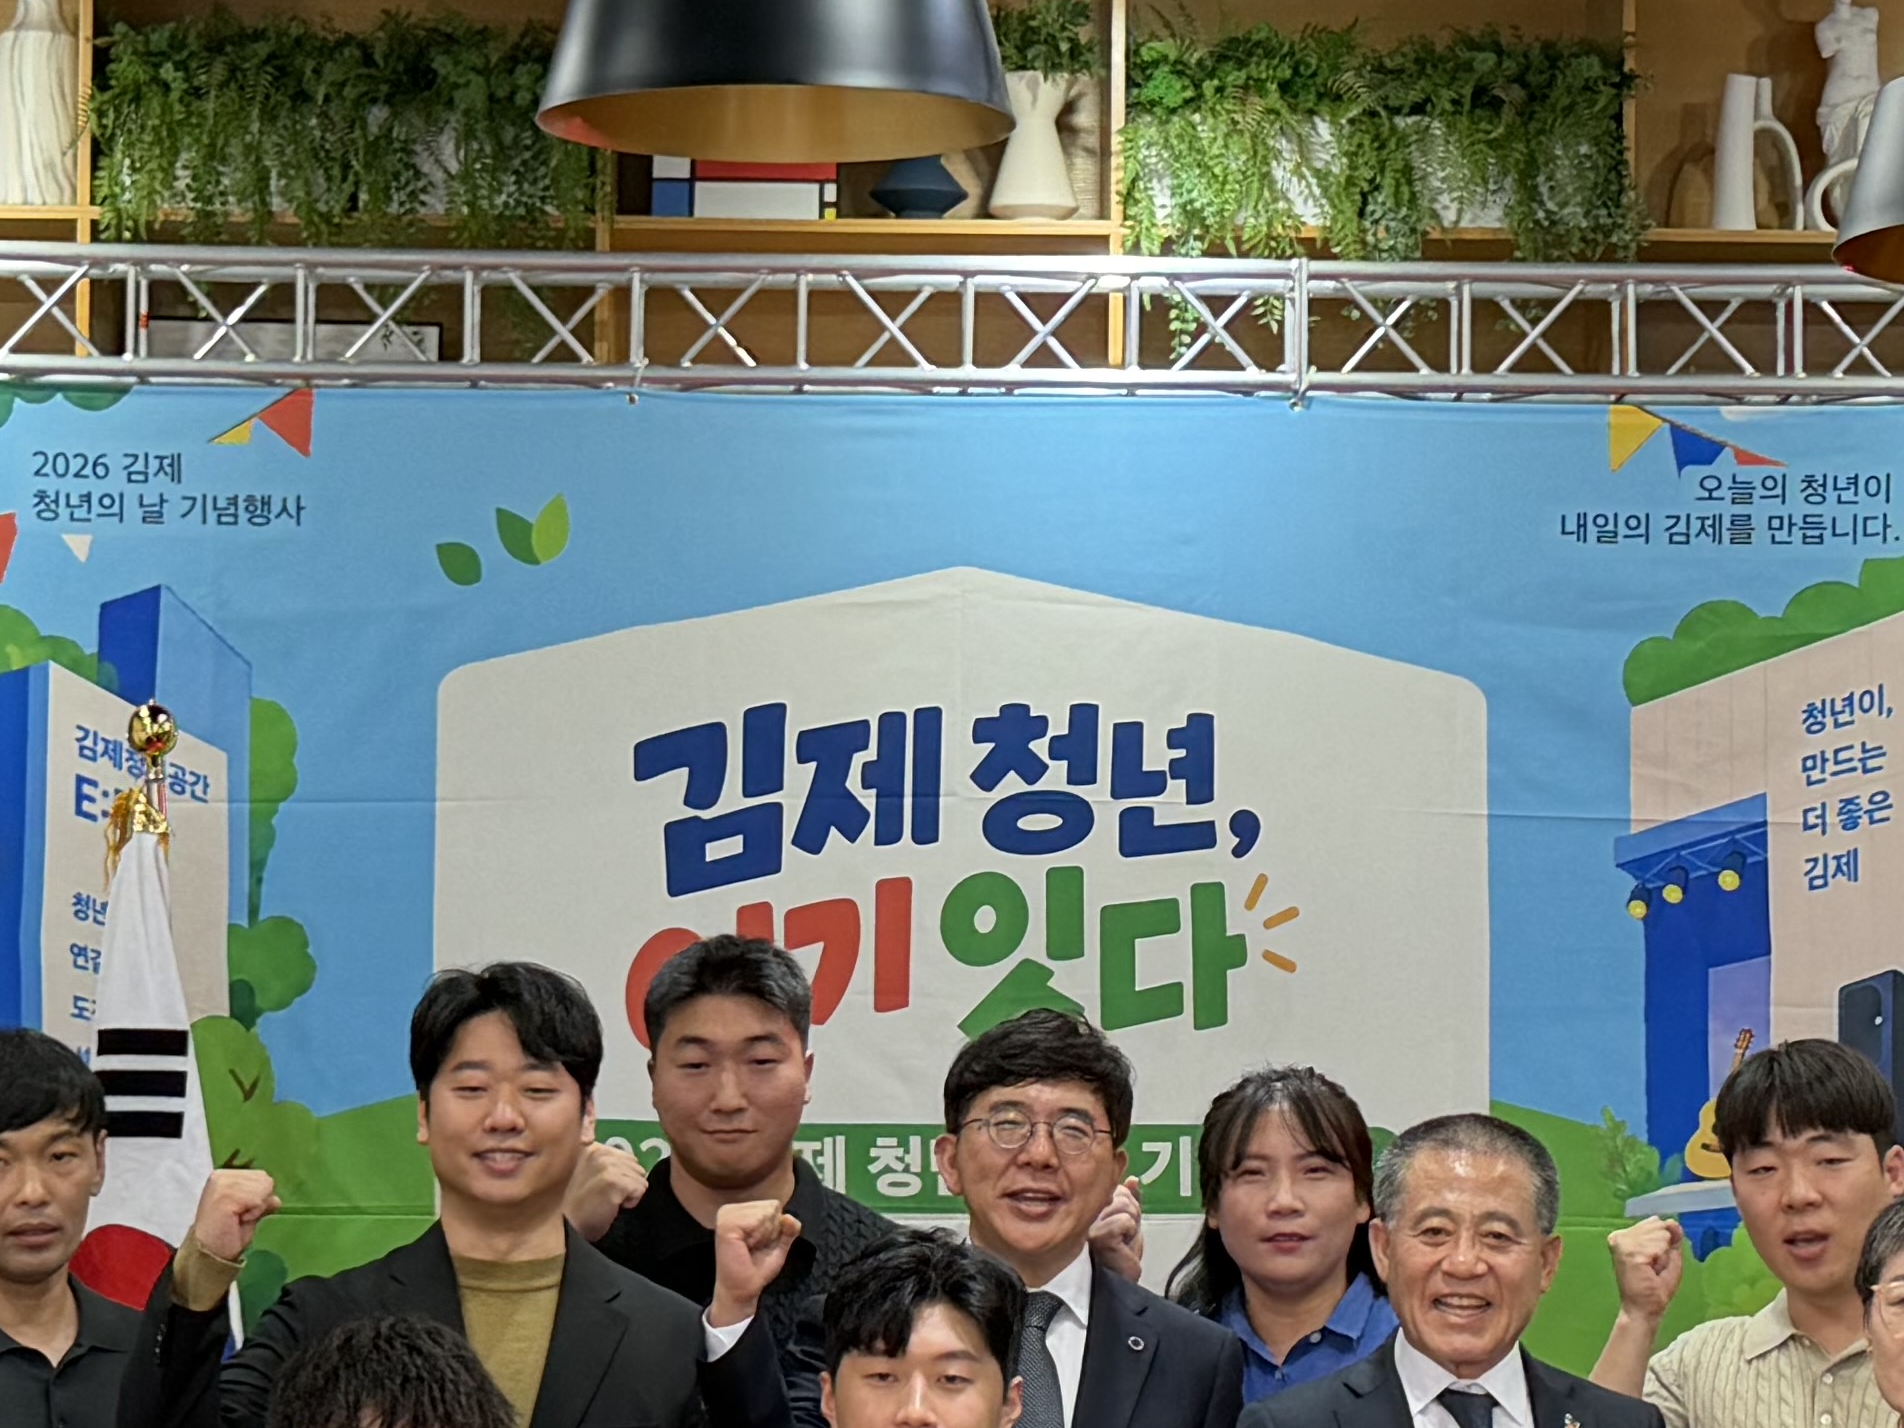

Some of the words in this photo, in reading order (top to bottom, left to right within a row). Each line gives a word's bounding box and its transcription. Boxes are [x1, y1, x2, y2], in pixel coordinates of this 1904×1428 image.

[32, 451, 110, 479] 2026
[122, 452, 182, 484] 김제
[1696, 473, 1788, 505] 오늘의
[1799, 473, 1892, 505] 청년이
[32, 489, 125, 523] 청년의
[138, 492, 168, 525] 날
[180, 494, 306, 527] 기념행사
[1560, 512, 1650, 545] 내일의
[1663, 513, 1756, 546] 김제를
[1767, 513, 1901, 546] 만듭니다.
[1802, 683, 1894, 735] 청년이,
[75, 724, 210, 803] 김제청공간
[1801, 741, 1887, 786] 만드는
[634, 702, 943, 898] 김제
[970, 702, 1262, 858] 청년,
[1802, 802, 1827, 836] 더
[1837, 790, 1894, 831] 좋은
[1804, 847, 1859, 890] 김제
